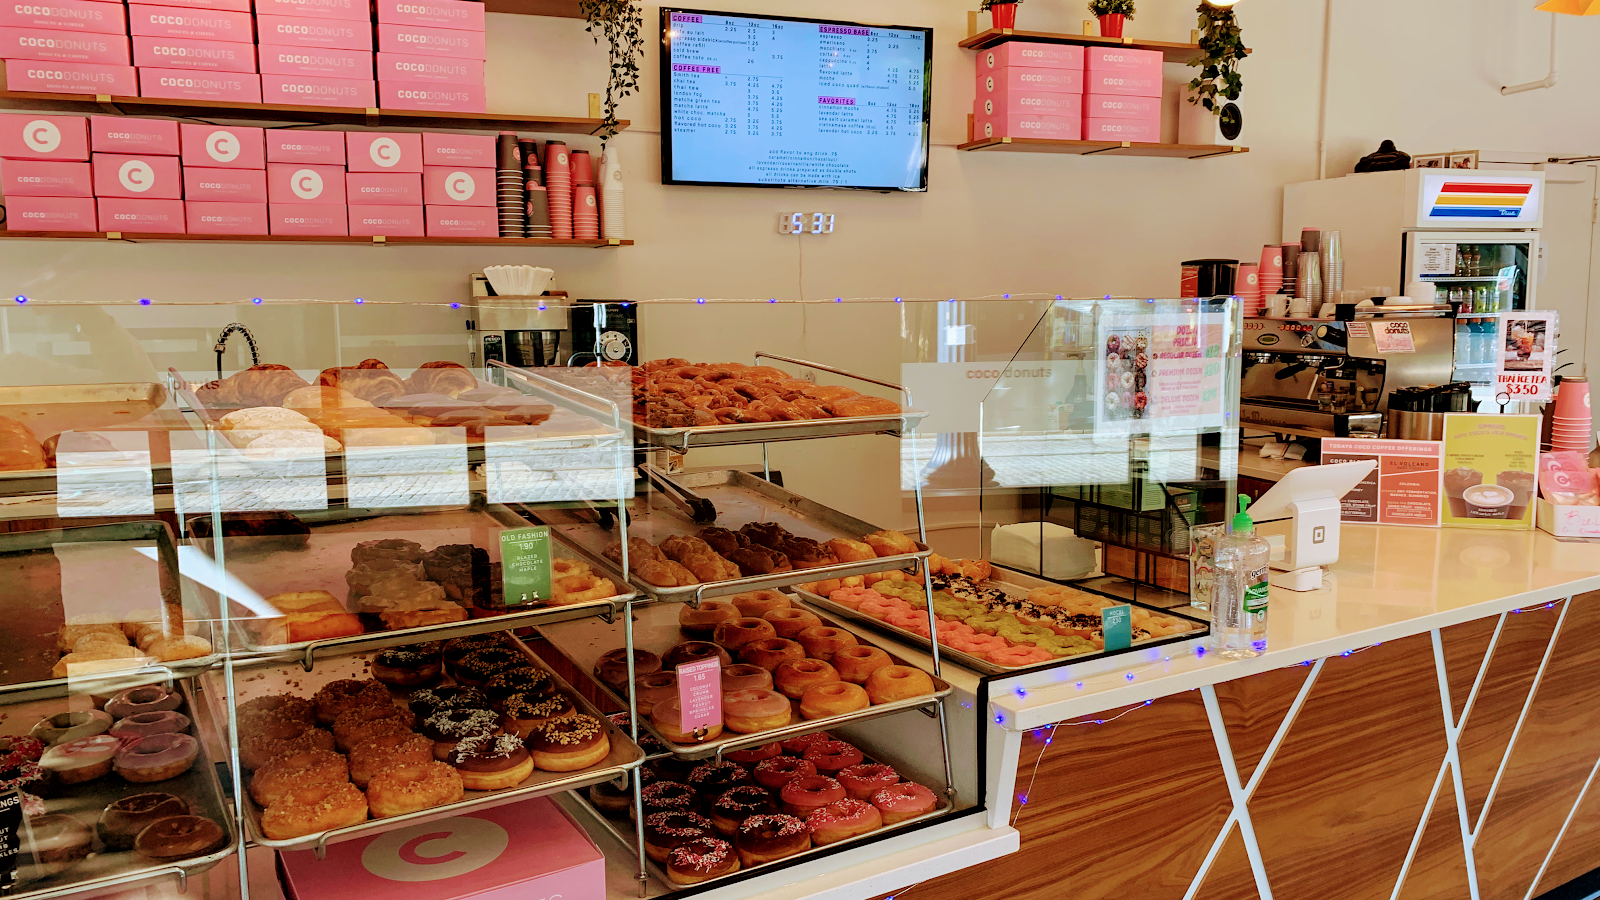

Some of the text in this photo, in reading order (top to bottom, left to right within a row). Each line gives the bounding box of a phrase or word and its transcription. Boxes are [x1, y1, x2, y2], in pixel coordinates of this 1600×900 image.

[820, 26, 852, 34] ESPRESSO
[673, 64, 700, 72] COFFEE
[966, 367, 1052, 378] coco donuts
[502, 531, 548, 542] OLD FASHION
[512, 559, 543, 567] CHOCOLATE
[679, 661, 718, 674] RAISED TOPPINGS
[690, 683, 711, 691] COCONUT
[690, 694, 713, 703] LAVENDER
